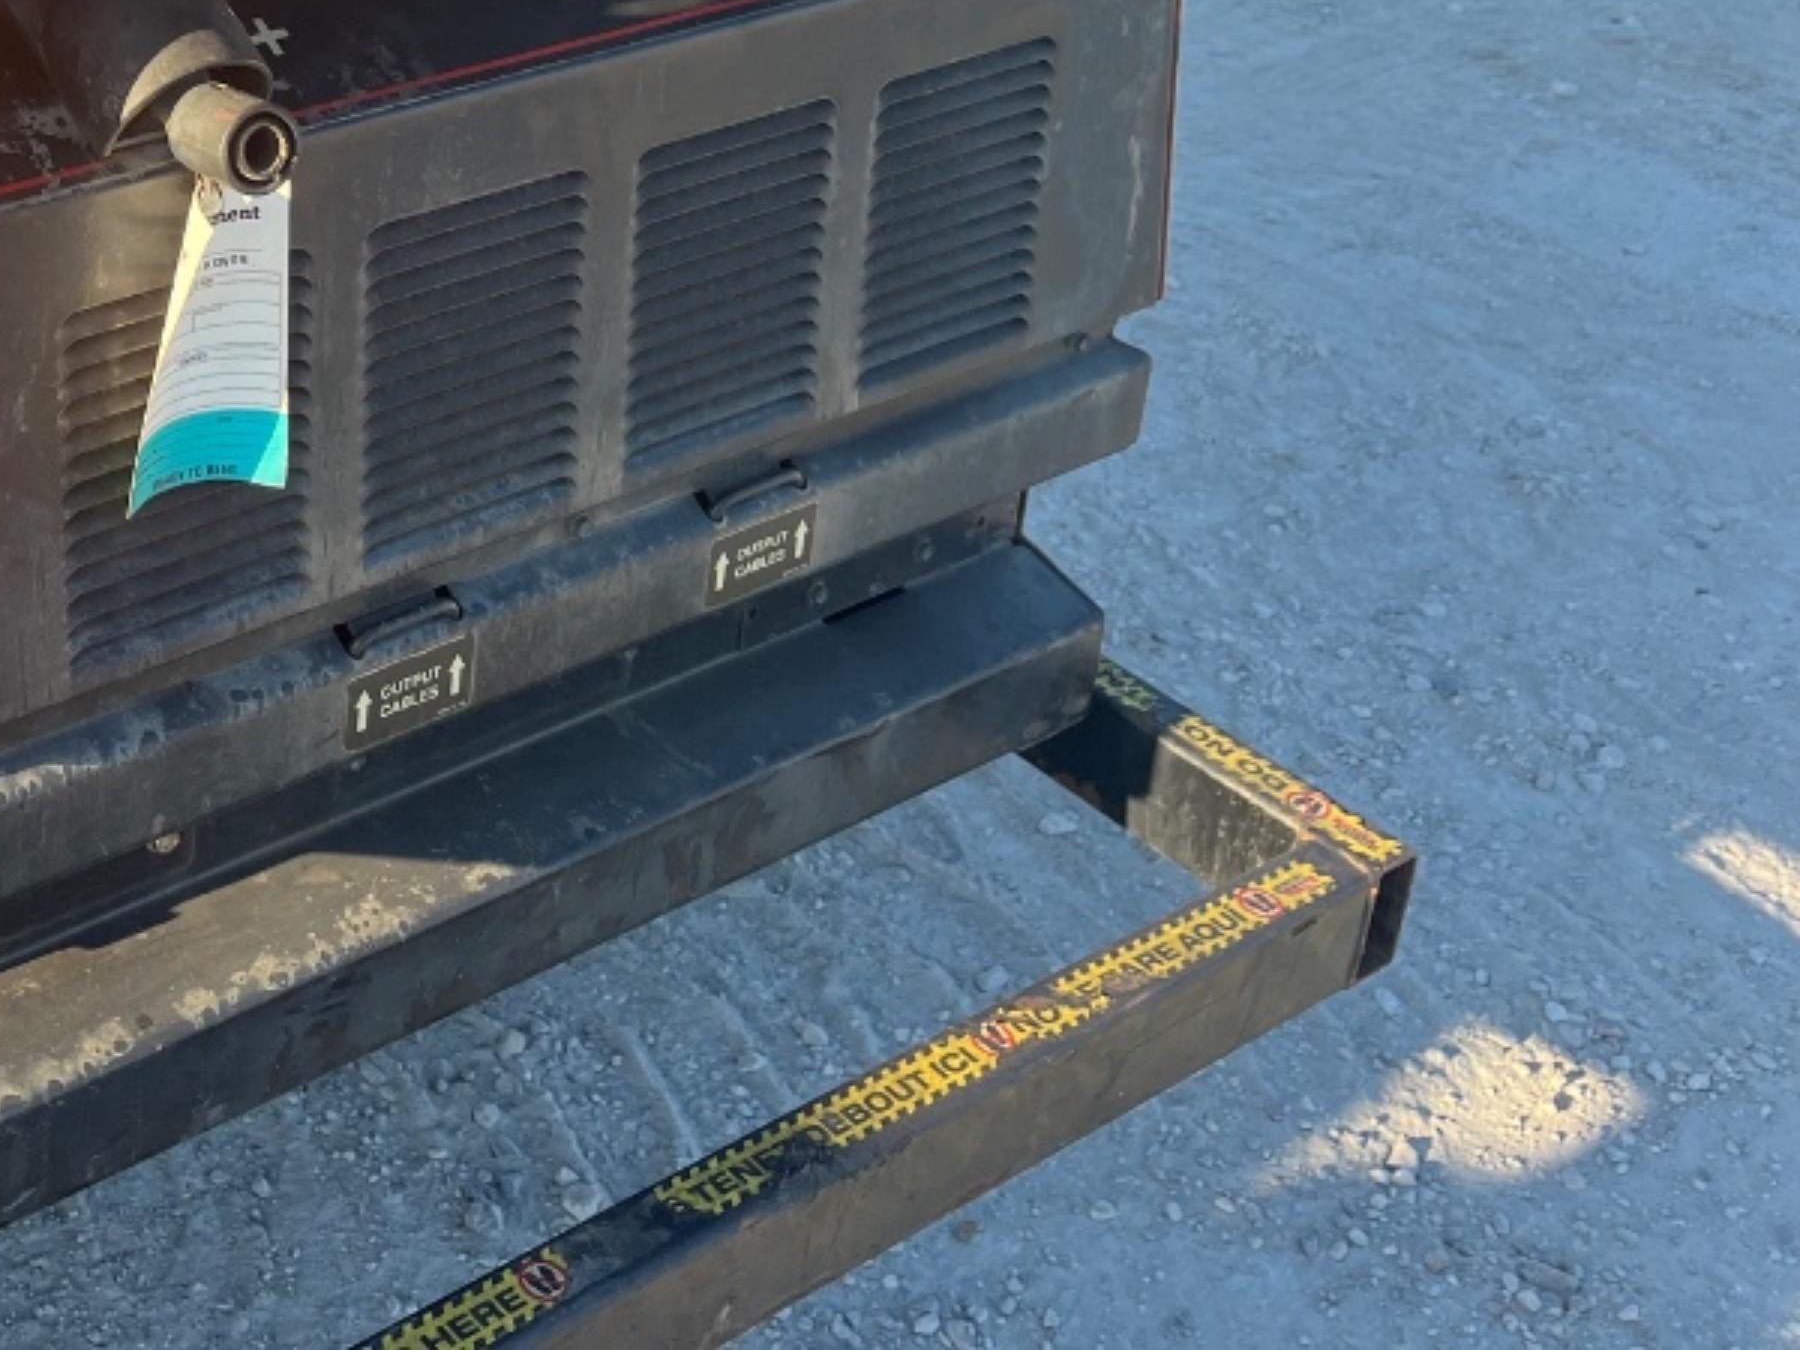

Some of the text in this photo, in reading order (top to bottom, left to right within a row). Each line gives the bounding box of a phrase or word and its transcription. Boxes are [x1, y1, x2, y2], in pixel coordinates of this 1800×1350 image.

[733, 547, 787, 580] CABLES
[735, 529, 788, 562] OUTPUT
[380, 664, 442, 700] OUTPUT
[379, 683, 439, 718] CABLES
[1235, 753, 1292, 794] DO
[802, 1070, 933, 1146] DEBOUT
[930, 1046, 979, 1081] ICI
[419, 1284, 529, 1350] HERE
